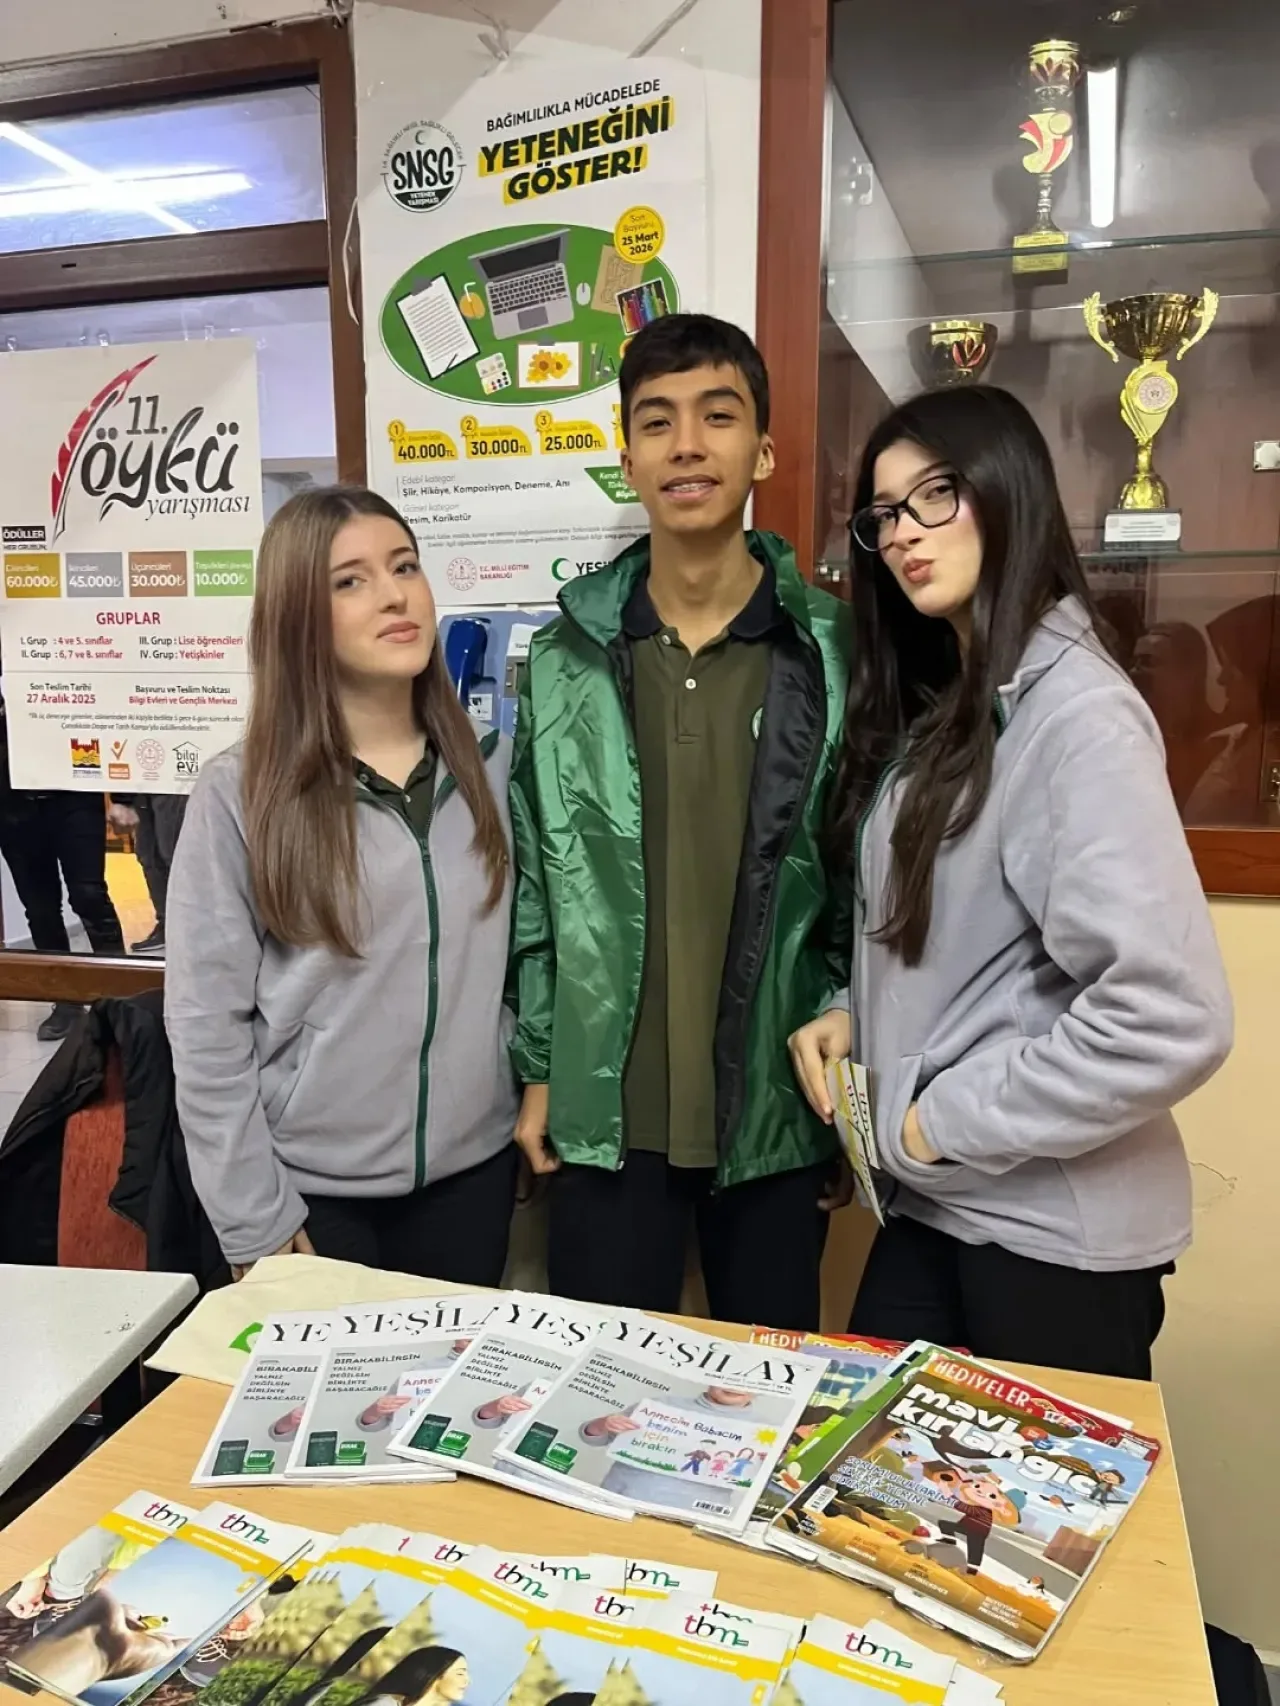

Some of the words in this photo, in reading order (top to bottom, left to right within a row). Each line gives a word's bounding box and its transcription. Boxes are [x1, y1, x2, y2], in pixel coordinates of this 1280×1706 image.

[486, 101, 571, 132] BAĞIMLILIKLA
[574, 78, 661, 111] MÜCADELEDE
[480, 95, 670, 173] YETENEĞİNİ
[391, 146, 455, 190] SNSG
[507, 146, 644, 201] GÖSTER!
[622, 235, 633, 246] 25
[635, 231, 659, 243] Mart
[629, 243, 654, 255] 2026
[126, 395, 168, 435] 11.
[466, 419, 473, 431] 2
[540, 415, 547, 426] 3
[80, 406, 240, 521] öykü
[453, 483, 513, 494] Kompozisyon,
[515, 481, 553, 491] Deneme,
[145, 496, 250, 521] yarışması
[432, 513, 472, 523] Karikatür
[3, 529, 45, 539] ÖDÜLLER
[96, 611, 161, 625] GRUPLAR
[26, 636, 48, 648] Grup
[58, 637, 63, 645] 4
[151, 636, 173, 646] Grup
[178, 636, 194, 645] Lise
[197, 636, 243, 647] öğrencileri
[30, 650, 51, 660] Grup
[140, 650, 151, 659] IV.
[152, 650, 174, 660] Grup
[179, 650, 225, 660] Yetişkinler
[30, 682, 44, 691] Son
[45, 682, 69, 691] Teslim
[70, 683, 92, 691] Tarihi
[135, 685, 165, 694] Başvuru
[177, 685, 200, 693] Teslim
[202, 686, 231, 694] Noktası
[26, 693, 39, 703] 27
[40, 693, 70, 704] Aralık
[71, 693, 96, 704] 2025
[129, 696, 145, 705] Bilgi
[147, 696, 167, 704] Evleri
[179, 696, 206, 706] Gençlik
[208, 697, 238, 705] Merkezi
[177, 761, 198, 773] evi
[334, 1353, 421, 1365] BIRAKABİLİRSİN
[481, 1344, 563, 1371] BIRAKABİLİRSİN
[614, 1320, 811, 1386] YEŞİLAY
[460, 1372, 518, 1391] BAŞARACAĞIZ
[589, 1358, 671, 1393] BIRAKABİLİRSİN
[568, 1383, 626, 1409] BAŞARACAĞIZ
[639, 1407, 691, 1427] Annecim
[905, 1383, 1021, 1436] mavi
[647, 1420, 688, 1438] benim
[143, 1501, 189, 1530] tbm
[219, 1512, 271, 1545] tbm
[434, 1544, 470, 1564] tb
[493, 1562, 549, 1599] tbm
[626, 1562, 680, 1587] bm
[593, 1595, 635, 1618] tb
[684, 1615, 750, 1647] tbm
[845, 1632, 914, 1669] tbm
